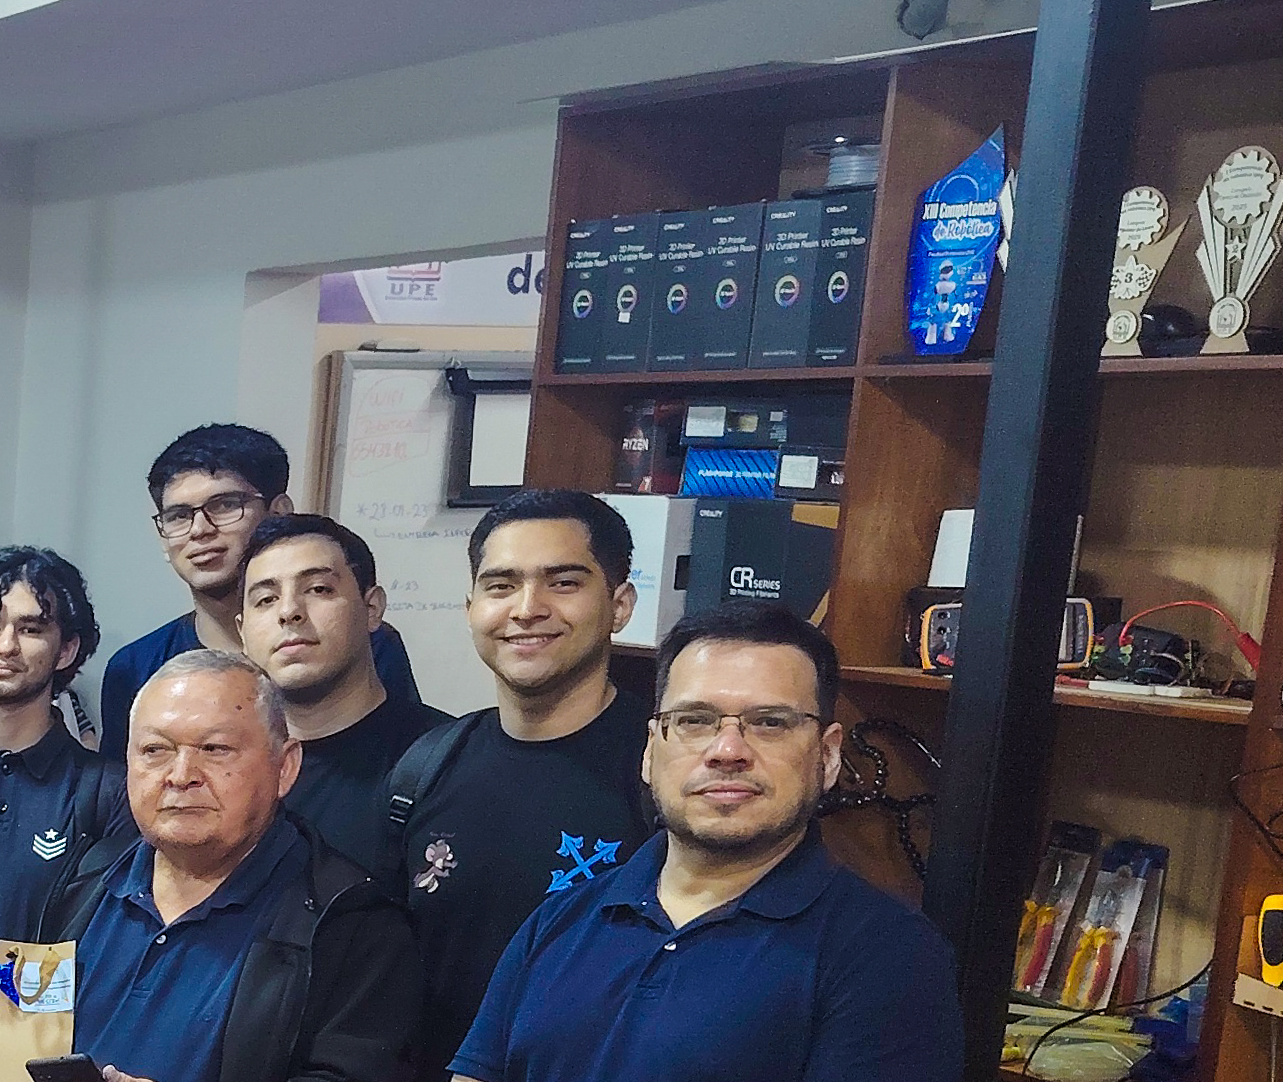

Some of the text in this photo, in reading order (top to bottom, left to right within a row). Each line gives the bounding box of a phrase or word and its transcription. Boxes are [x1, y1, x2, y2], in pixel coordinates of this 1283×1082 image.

[939, 199, 997, 219] Competencia
[1124, 272, 1133, 283] 3
[389, 282, 436, 296] UPE
[622, 438, 649, 450] RYZEN
[730, 566, 781, 590] CR SERIES
